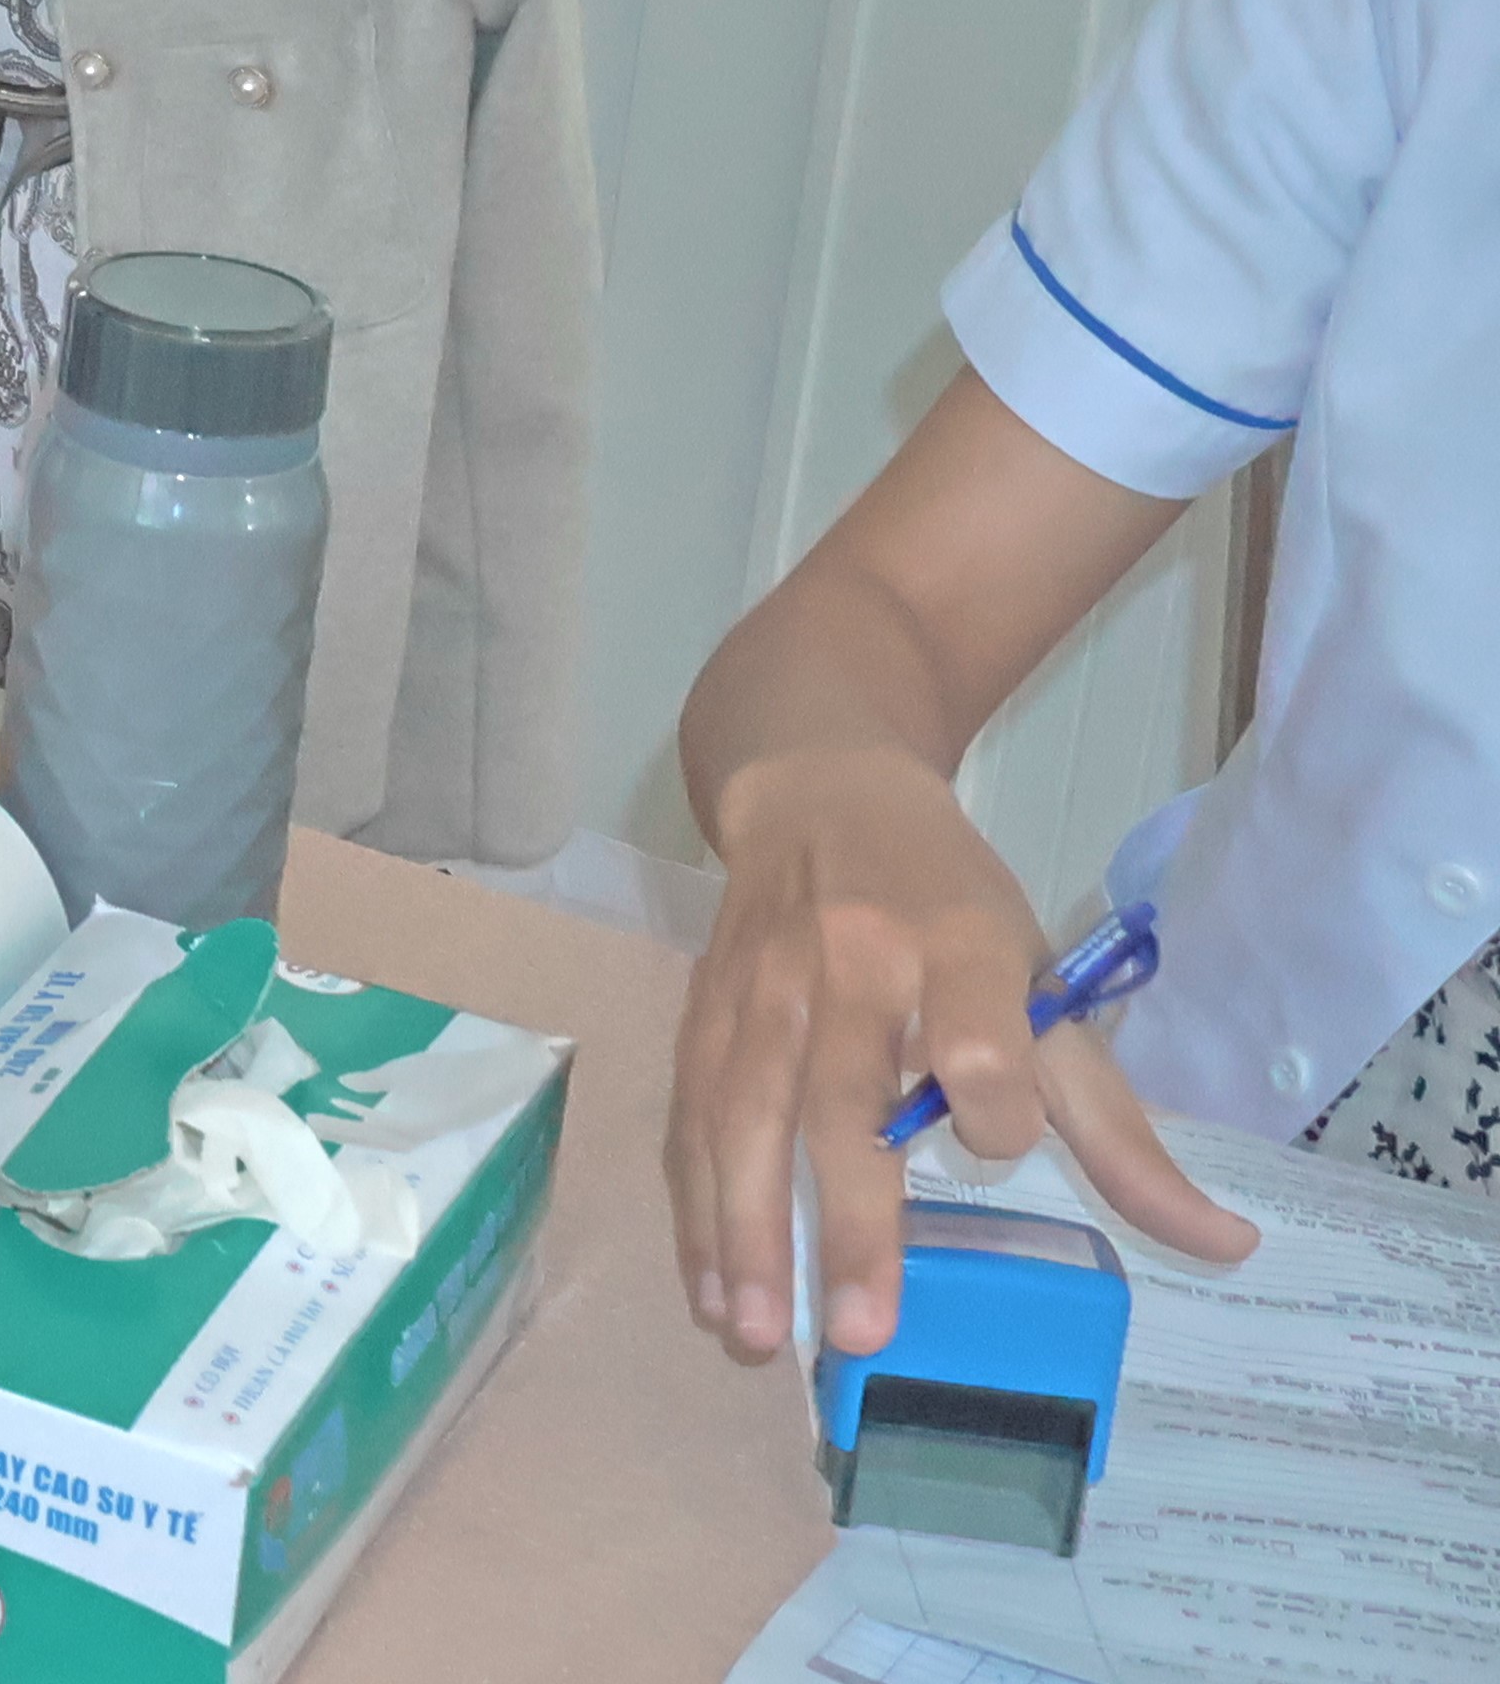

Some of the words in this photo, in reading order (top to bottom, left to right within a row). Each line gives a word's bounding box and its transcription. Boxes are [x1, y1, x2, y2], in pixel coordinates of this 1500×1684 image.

[33, 1464, 89, 1506] CAO
[96, 1485, 135, 1522] SU
[143, 1500, 159, 1529] Y
[168, 1509, 205, 1544] TẾ
[46, 1507, 100, 1545] mm
